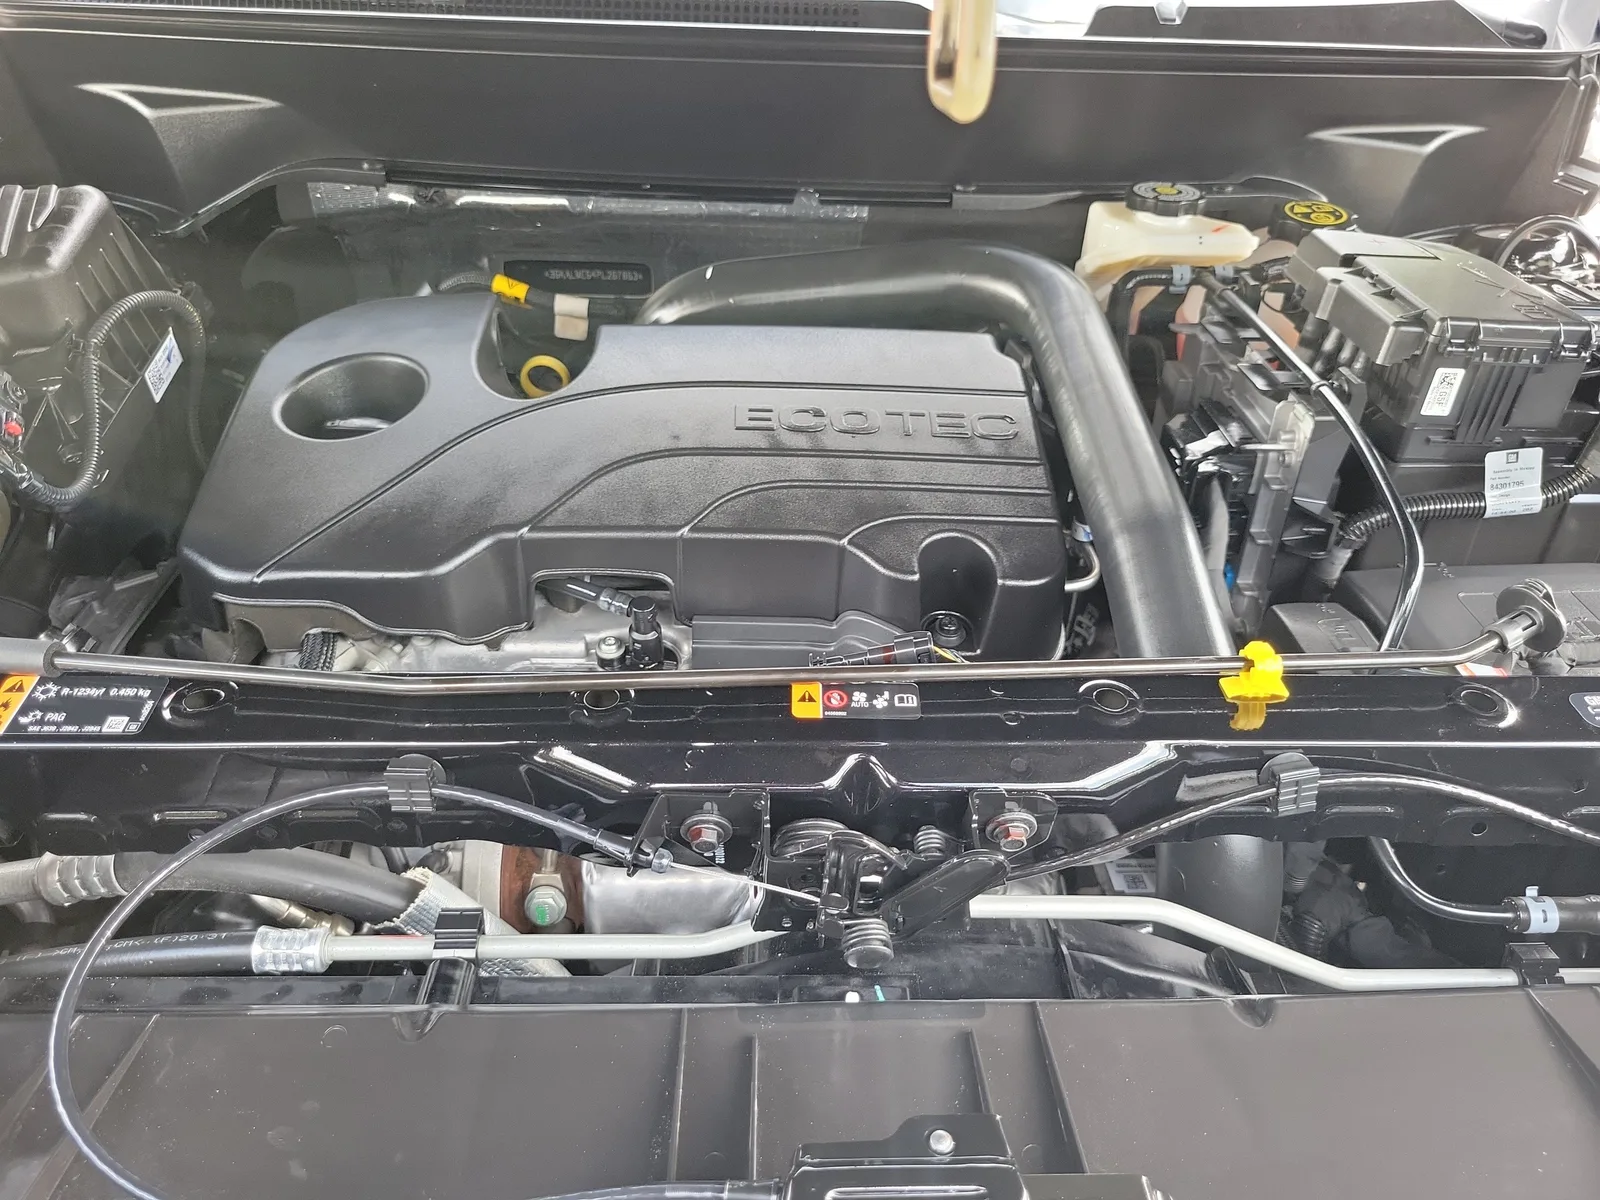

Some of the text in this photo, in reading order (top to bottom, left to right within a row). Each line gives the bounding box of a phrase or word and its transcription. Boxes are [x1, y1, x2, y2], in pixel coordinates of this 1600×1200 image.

[734, 404, 1018, 440] ECOTEC
[1490, 480, 1525, 491] 84301795
[110, 687, 137, 696] 0.450
[45, 713, 66, 721] PAG
